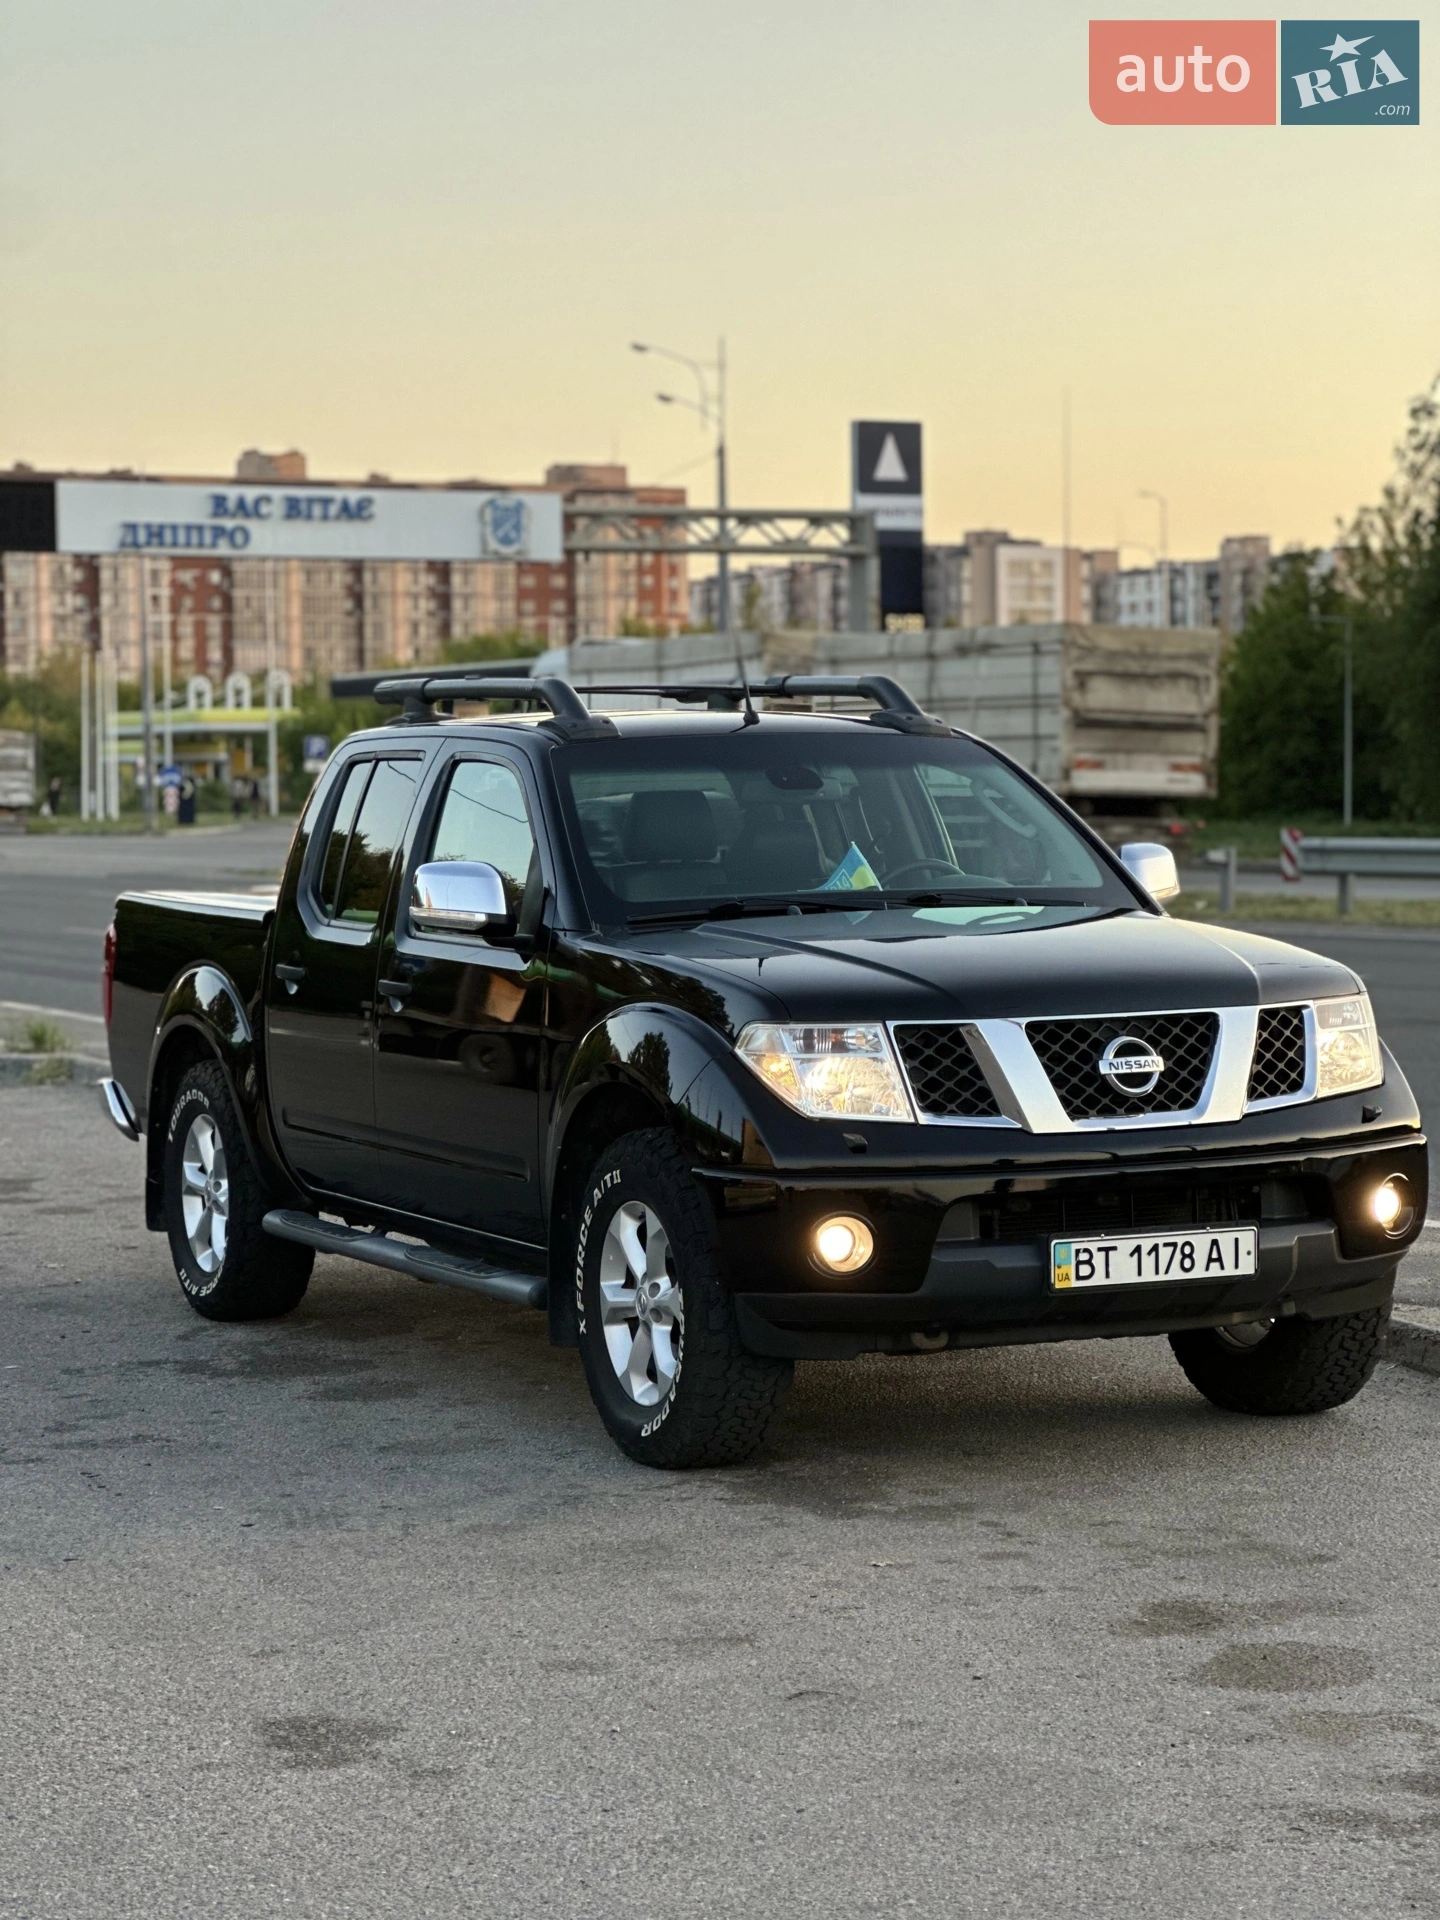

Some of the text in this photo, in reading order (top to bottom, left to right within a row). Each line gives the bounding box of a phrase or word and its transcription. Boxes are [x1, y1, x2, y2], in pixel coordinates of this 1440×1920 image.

[209, 494, 376, 521] ВАС ВІТАЄ
[118, 522, 252, 550] ДНІПРО
[1108, 1059, 1160, 1071] NISSAN
[168, 1089, 210, 1143] TOURADOR
[576, 1205, 593, 1312] FORCE
[1075, 1237, 1240, 1281] BT 1178 AI
[1057, 1272, 1071, 1282] UA
